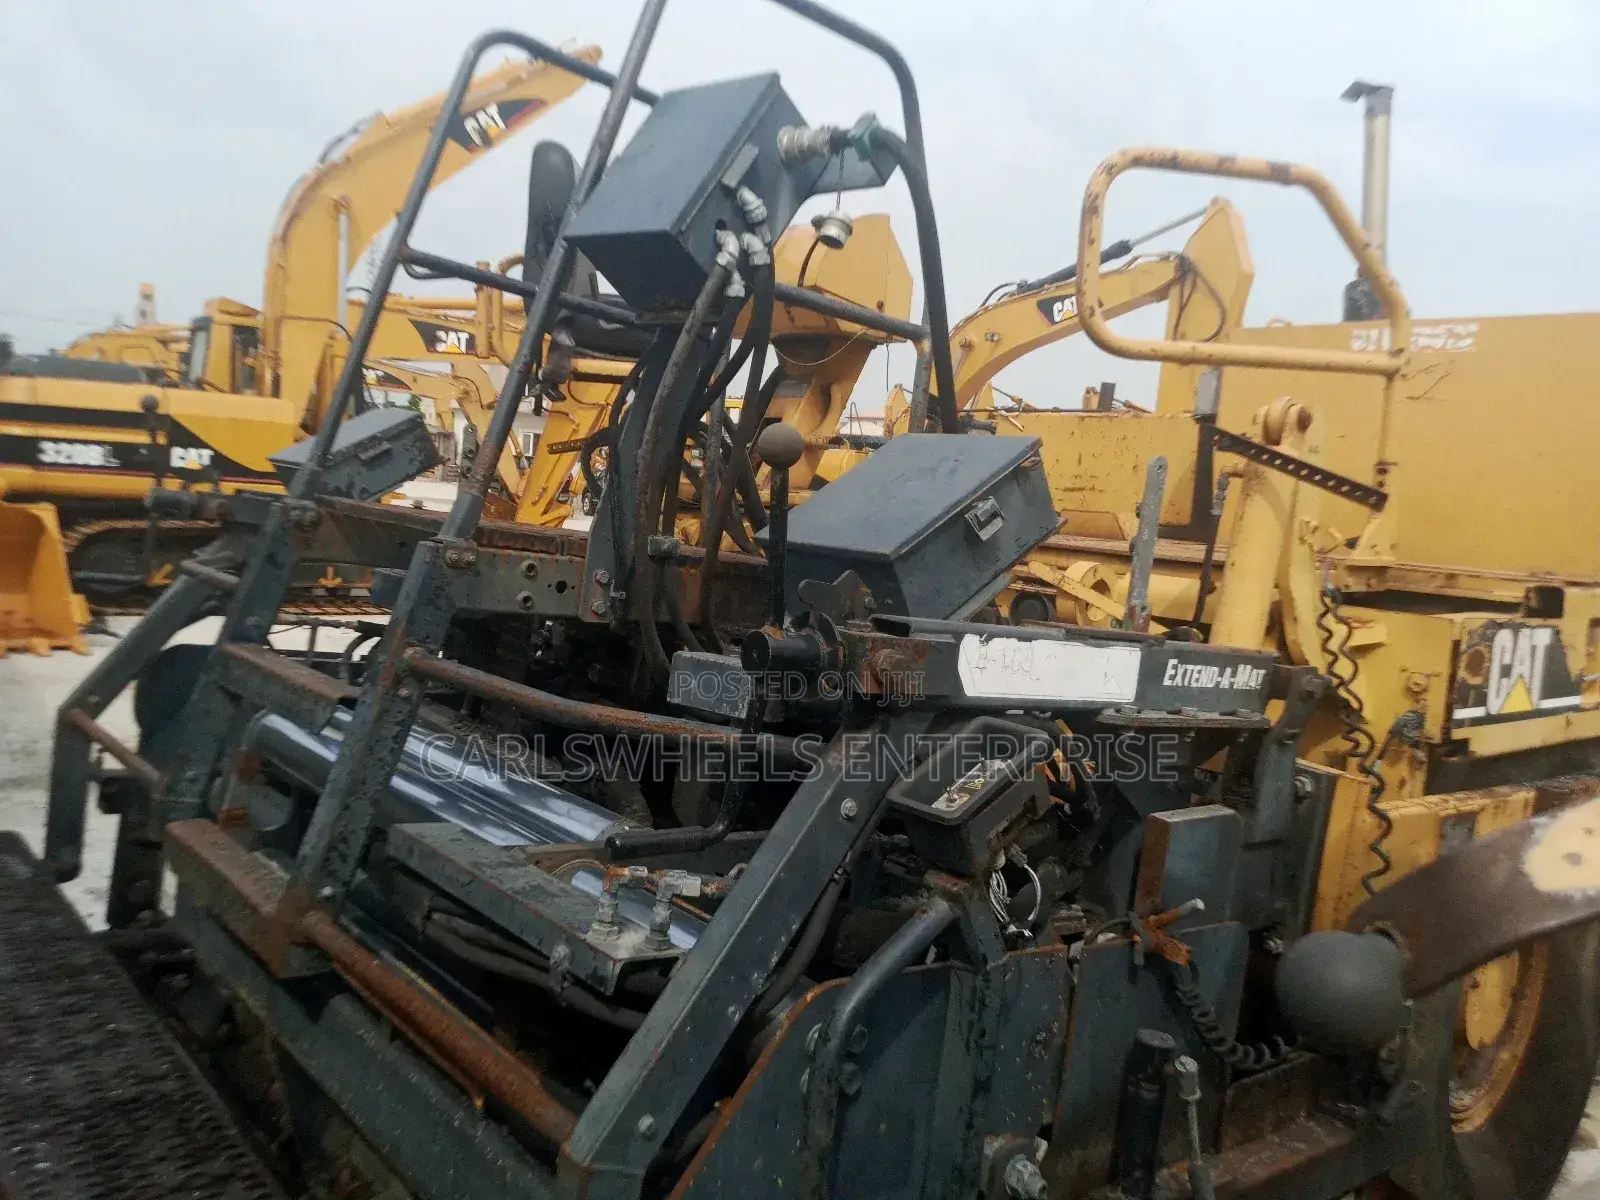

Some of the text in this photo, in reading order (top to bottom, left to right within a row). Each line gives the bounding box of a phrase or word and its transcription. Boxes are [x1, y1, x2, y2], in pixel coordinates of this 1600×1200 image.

[463, 102, 508, 148] CAT
[434, 329, 470, 354] CAT
[169, 445, 215, 470] CAT
[1486, 627, 1553, 715] CAT
